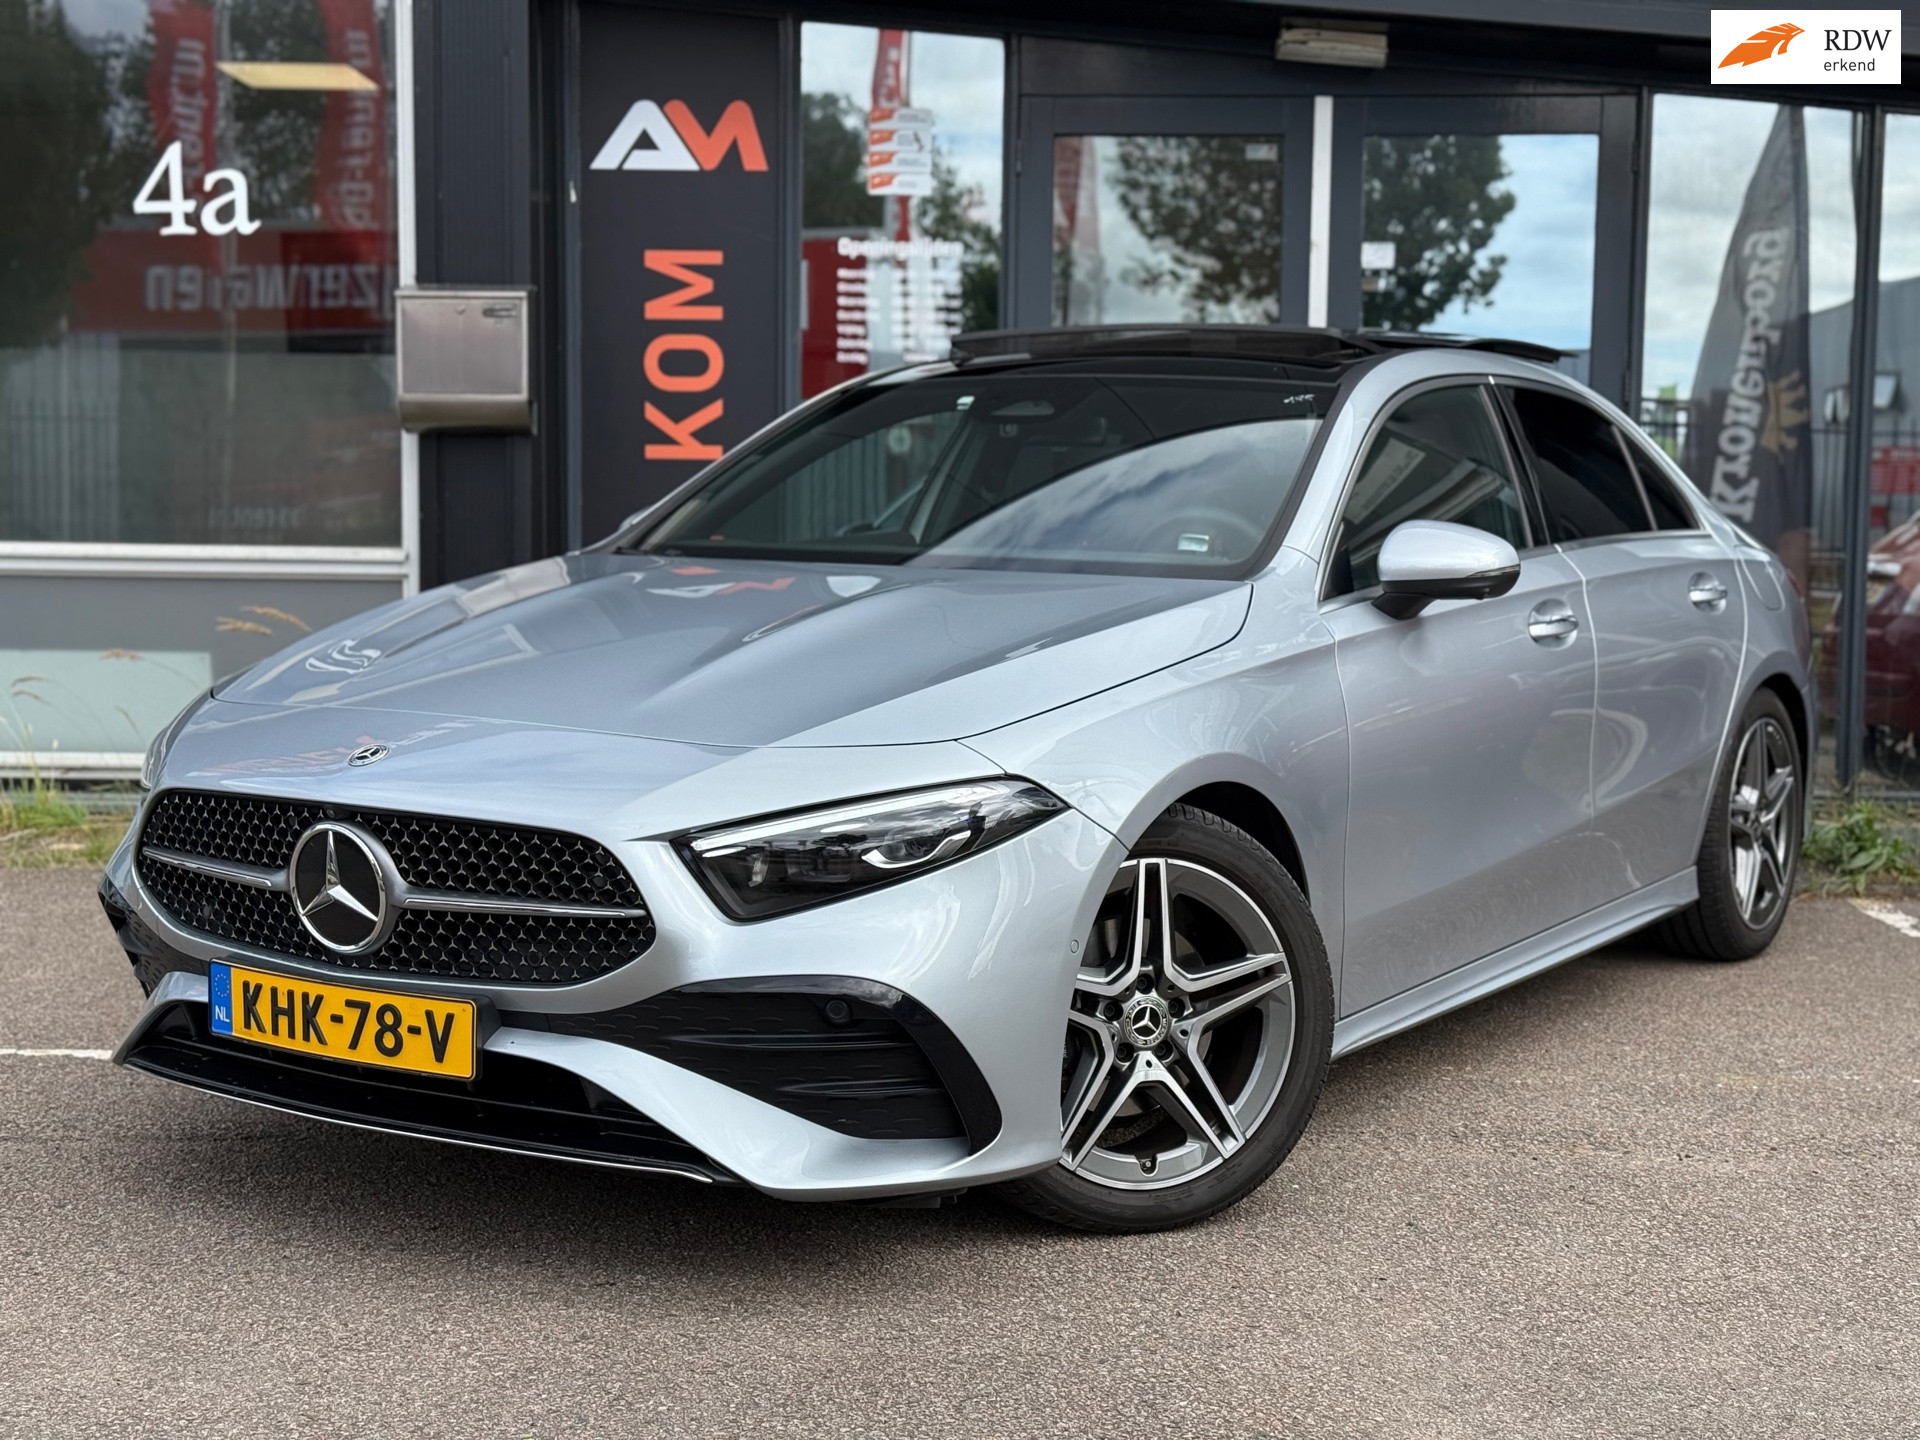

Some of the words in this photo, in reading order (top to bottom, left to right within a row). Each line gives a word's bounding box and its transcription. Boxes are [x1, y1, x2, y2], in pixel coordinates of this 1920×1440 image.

[589, 99, 769, 172] AM
[133, 141, 261, 236] 4a
[643, 249, 725, 460] KOM
[215, 1004, 230, 1024] NL
[242, 980, 455, 1064] KHK-78-V
